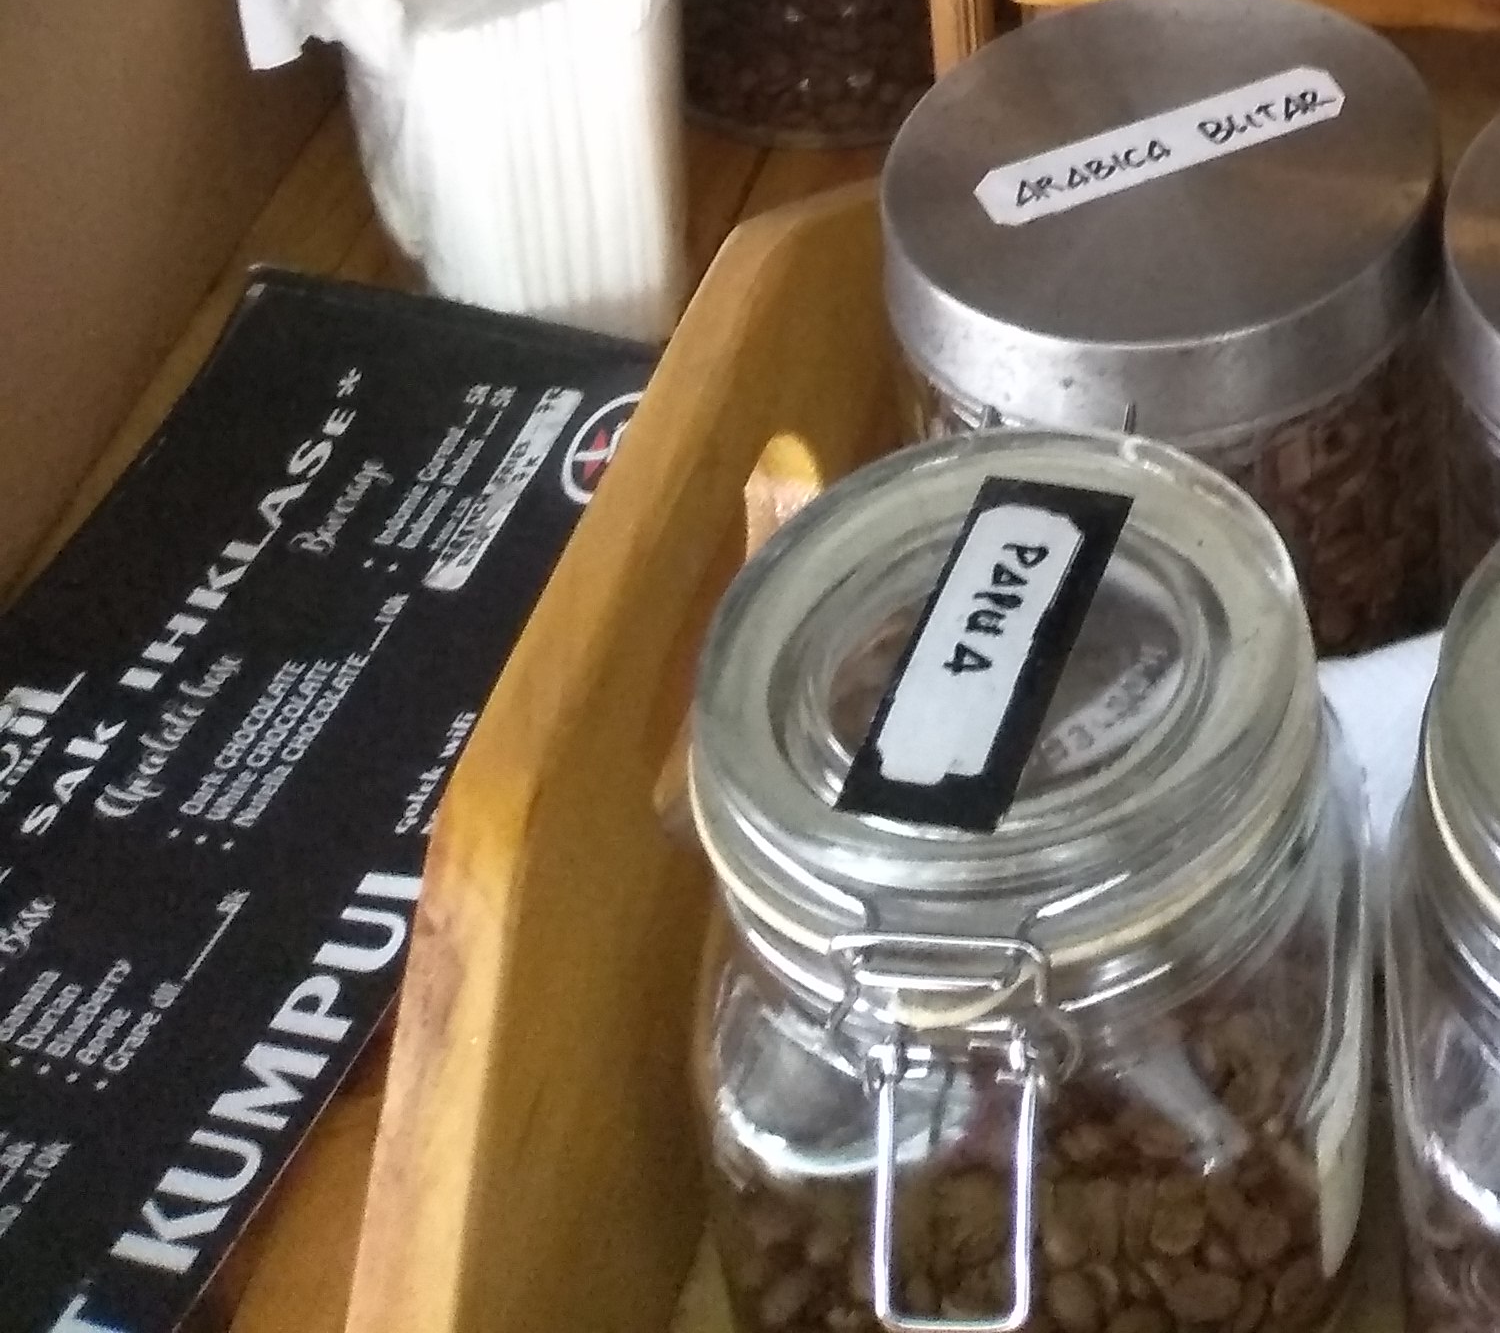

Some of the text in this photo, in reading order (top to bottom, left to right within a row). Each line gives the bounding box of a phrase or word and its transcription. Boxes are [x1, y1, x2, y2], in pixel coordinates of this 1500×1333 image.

[1015, 139, 1172, 208] ARABICA
[179, 661, 305, 816] Dark CHOCOLATE
[246, 661, 336, 768] CHOCOLATE
[281, 653, 370, 762] CHOCOLATE
[16, 984, 82, 1050] Durian
[45, 960, 131, 1057] Blueberry
[103, 1011, 162, 1072] Grape
